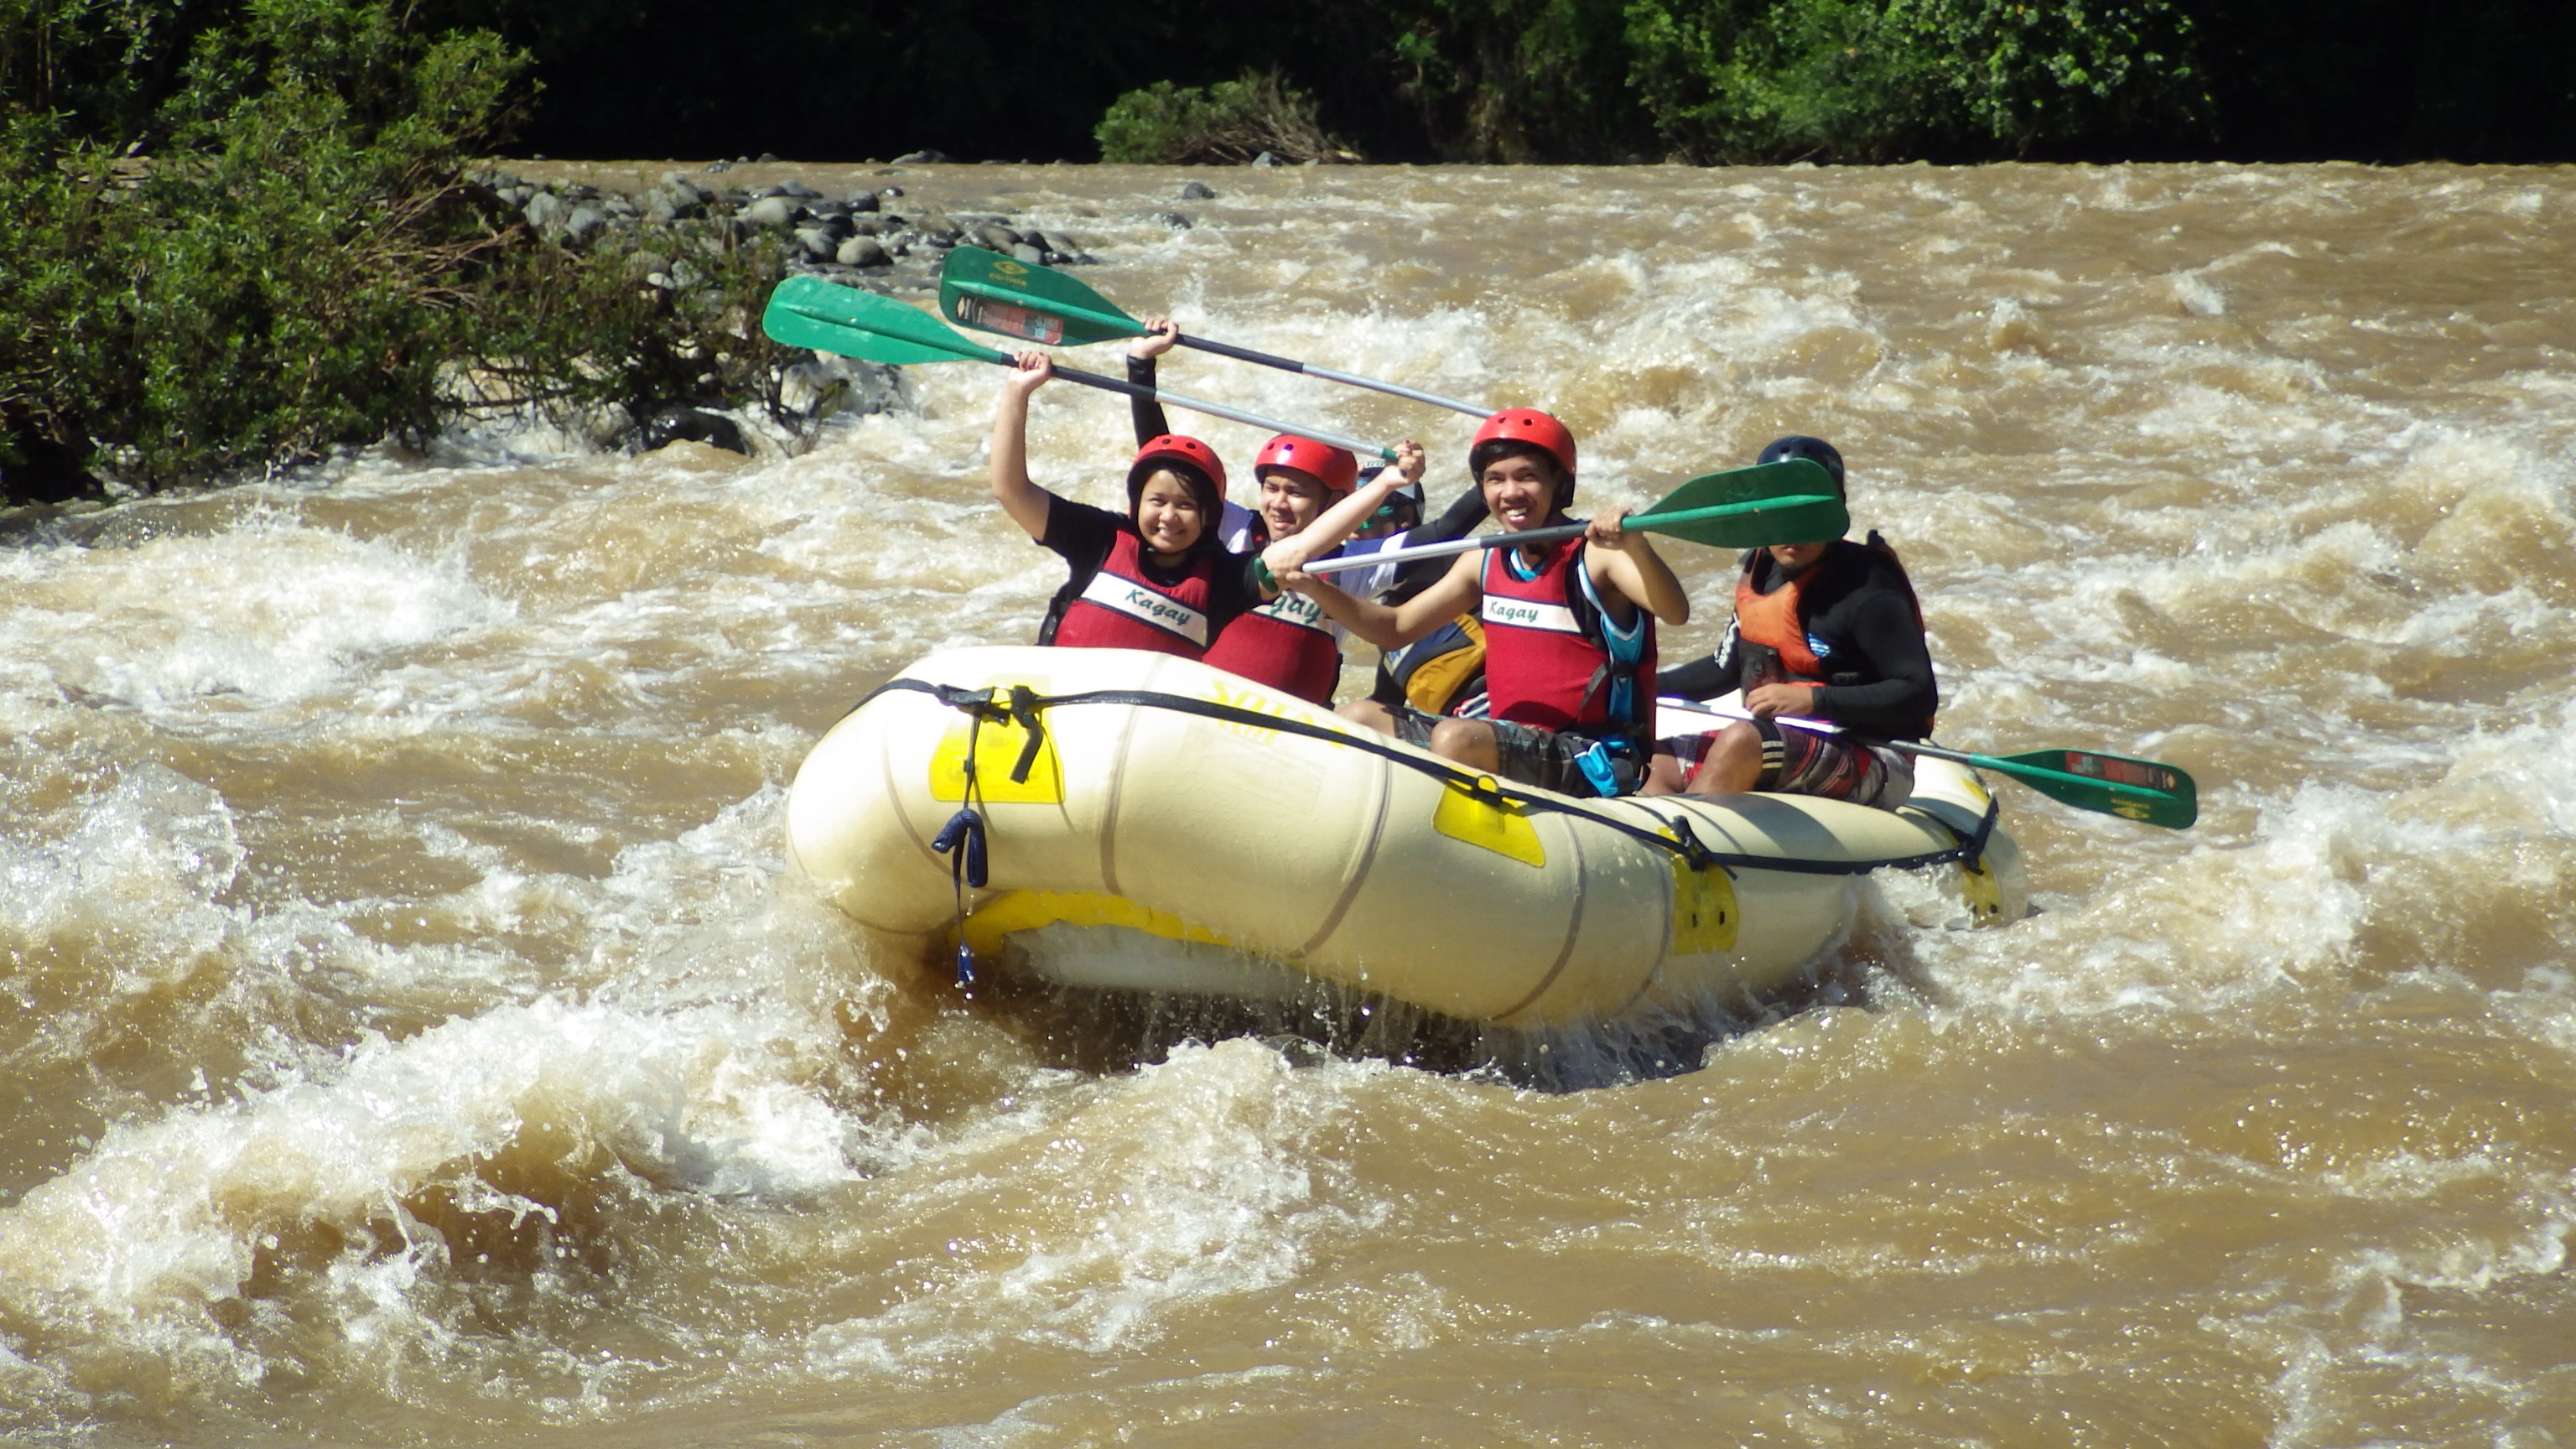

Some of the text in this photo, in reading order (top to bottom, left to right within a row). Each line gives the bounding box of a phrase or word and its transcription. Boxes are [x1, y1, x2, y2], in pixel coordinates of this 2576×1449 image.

[1125, 589, 1191, 626] Kagay
[1270, 595, 1322, 624] gay
[1489, 600, 1539, 623] Kagay
